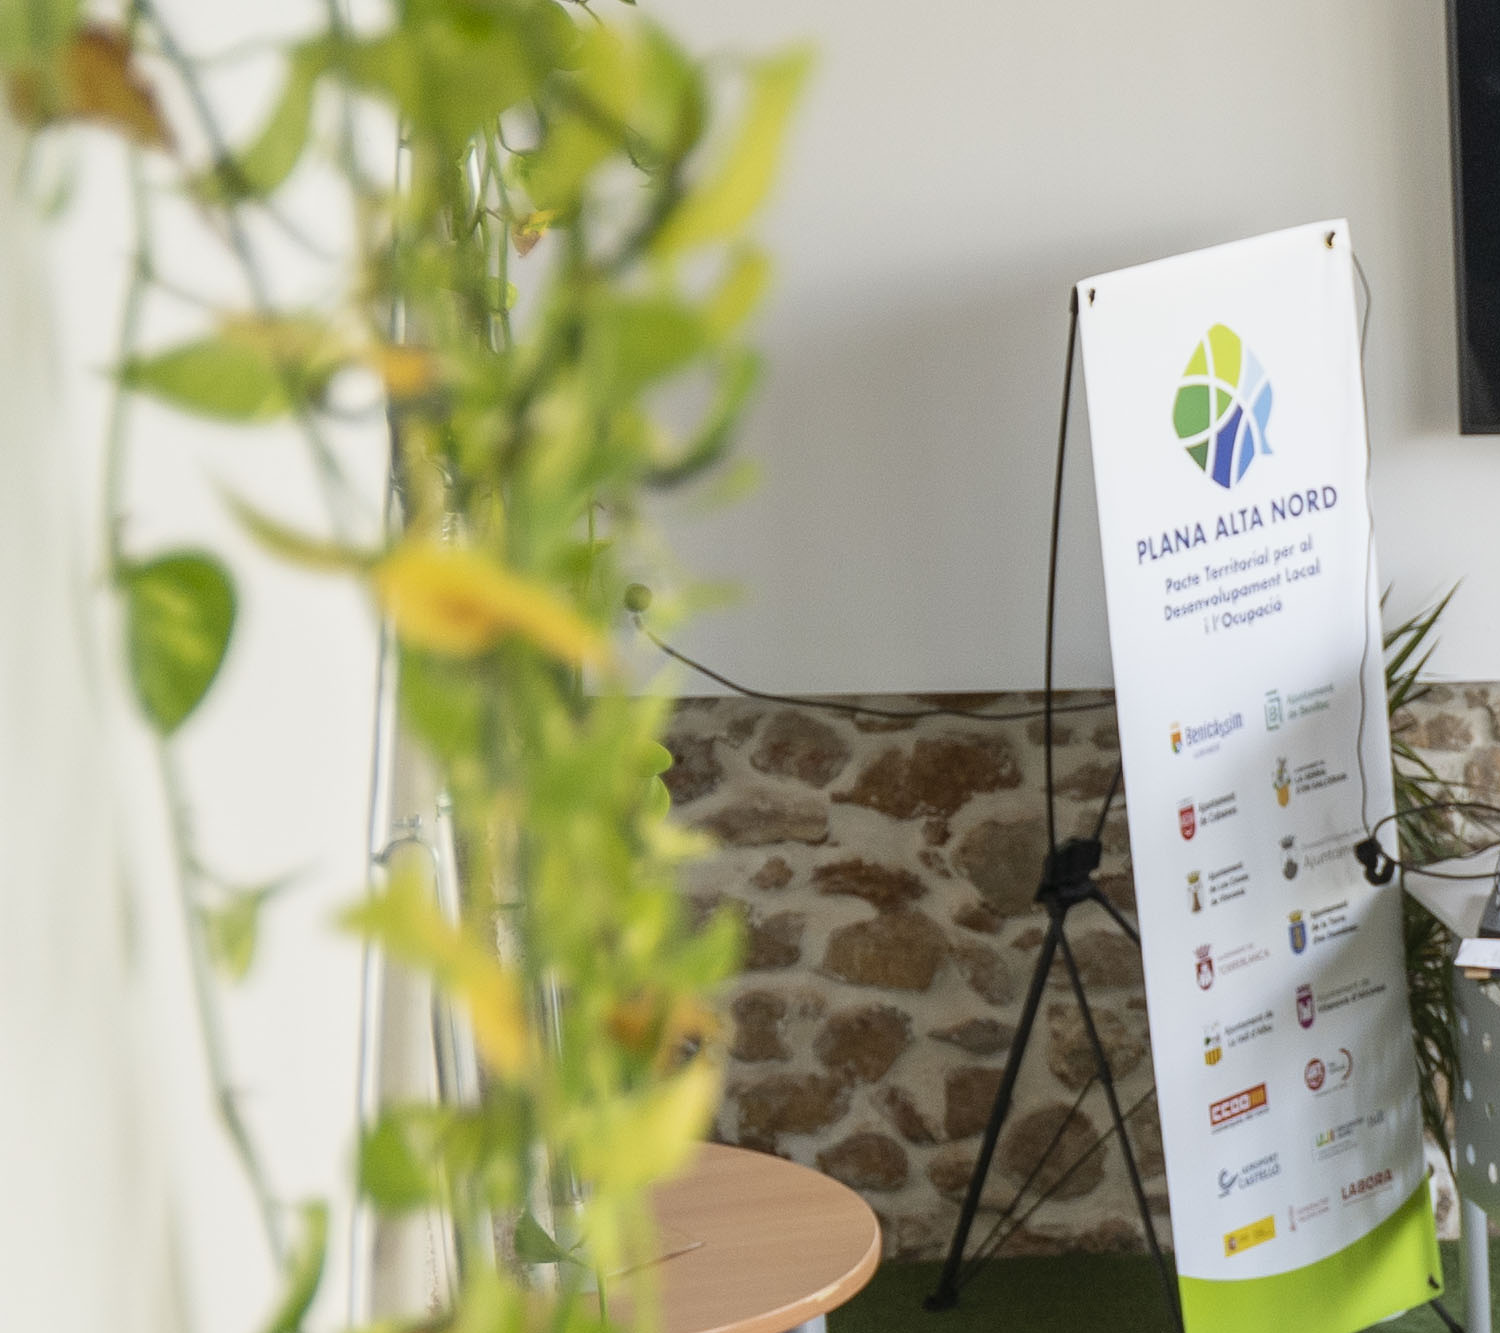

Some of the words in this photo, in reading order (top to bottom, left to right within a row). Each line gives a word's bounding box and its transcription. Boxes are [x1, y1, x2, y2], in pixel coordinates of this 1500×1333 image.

[1137, 522, 1207, 564] PLANA
[1214, 505, 1264, 541] ALTA
[1271, 485, 1338, 524] NORD
[1163, 572, 1281, 622] Desenvolupament
[1285, 556, 1322, 584] Local
[1165, 572, 1200, 595] Pacte
[1204, 546, 1270, 582] Territorial
[1273, 543, 1295, 564] per
[1299, 533, 1313, 553] al
[1341, 1168, 1393, 1200] LABORA
